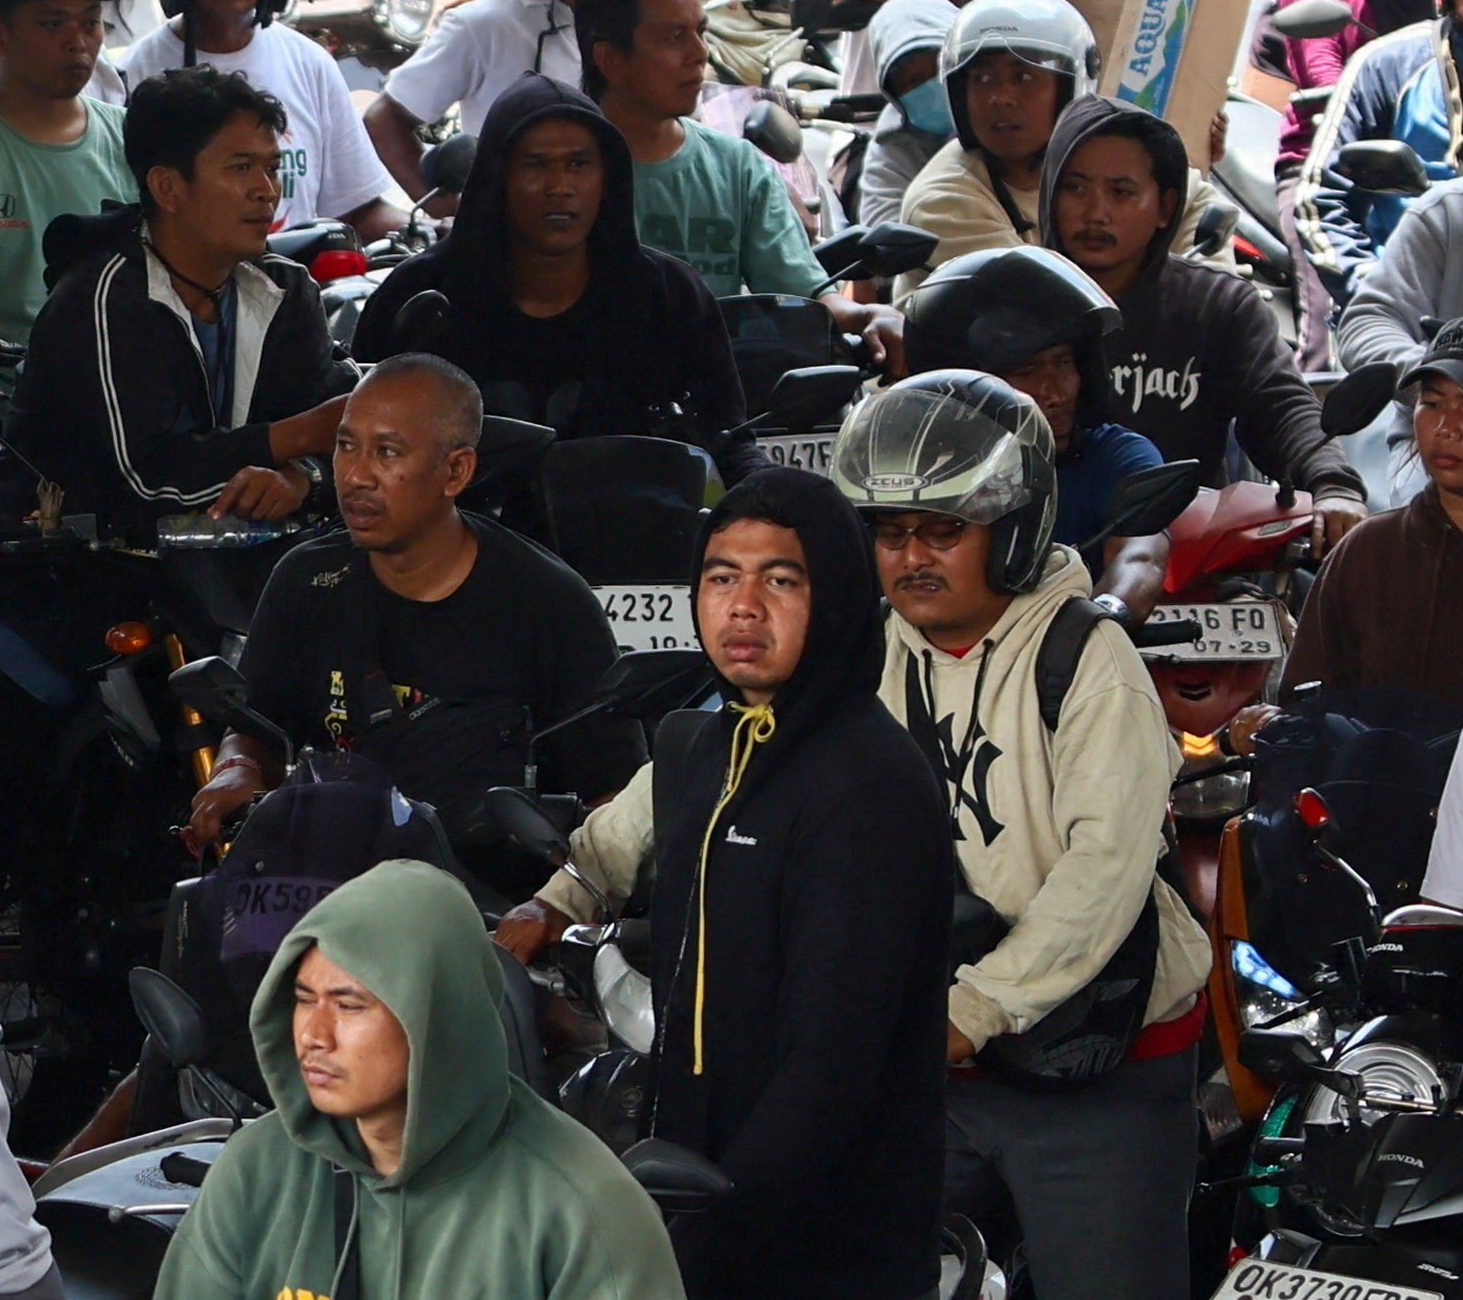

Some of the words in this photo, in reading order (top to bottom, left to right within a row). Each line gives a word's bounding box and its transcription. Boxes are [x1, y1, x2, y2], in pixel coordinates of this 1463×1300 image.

[281, 149, 307, 177] ng
[605, 593, 675, 621] 4232
[1378, 1153, 1425, 1169] HONDA
